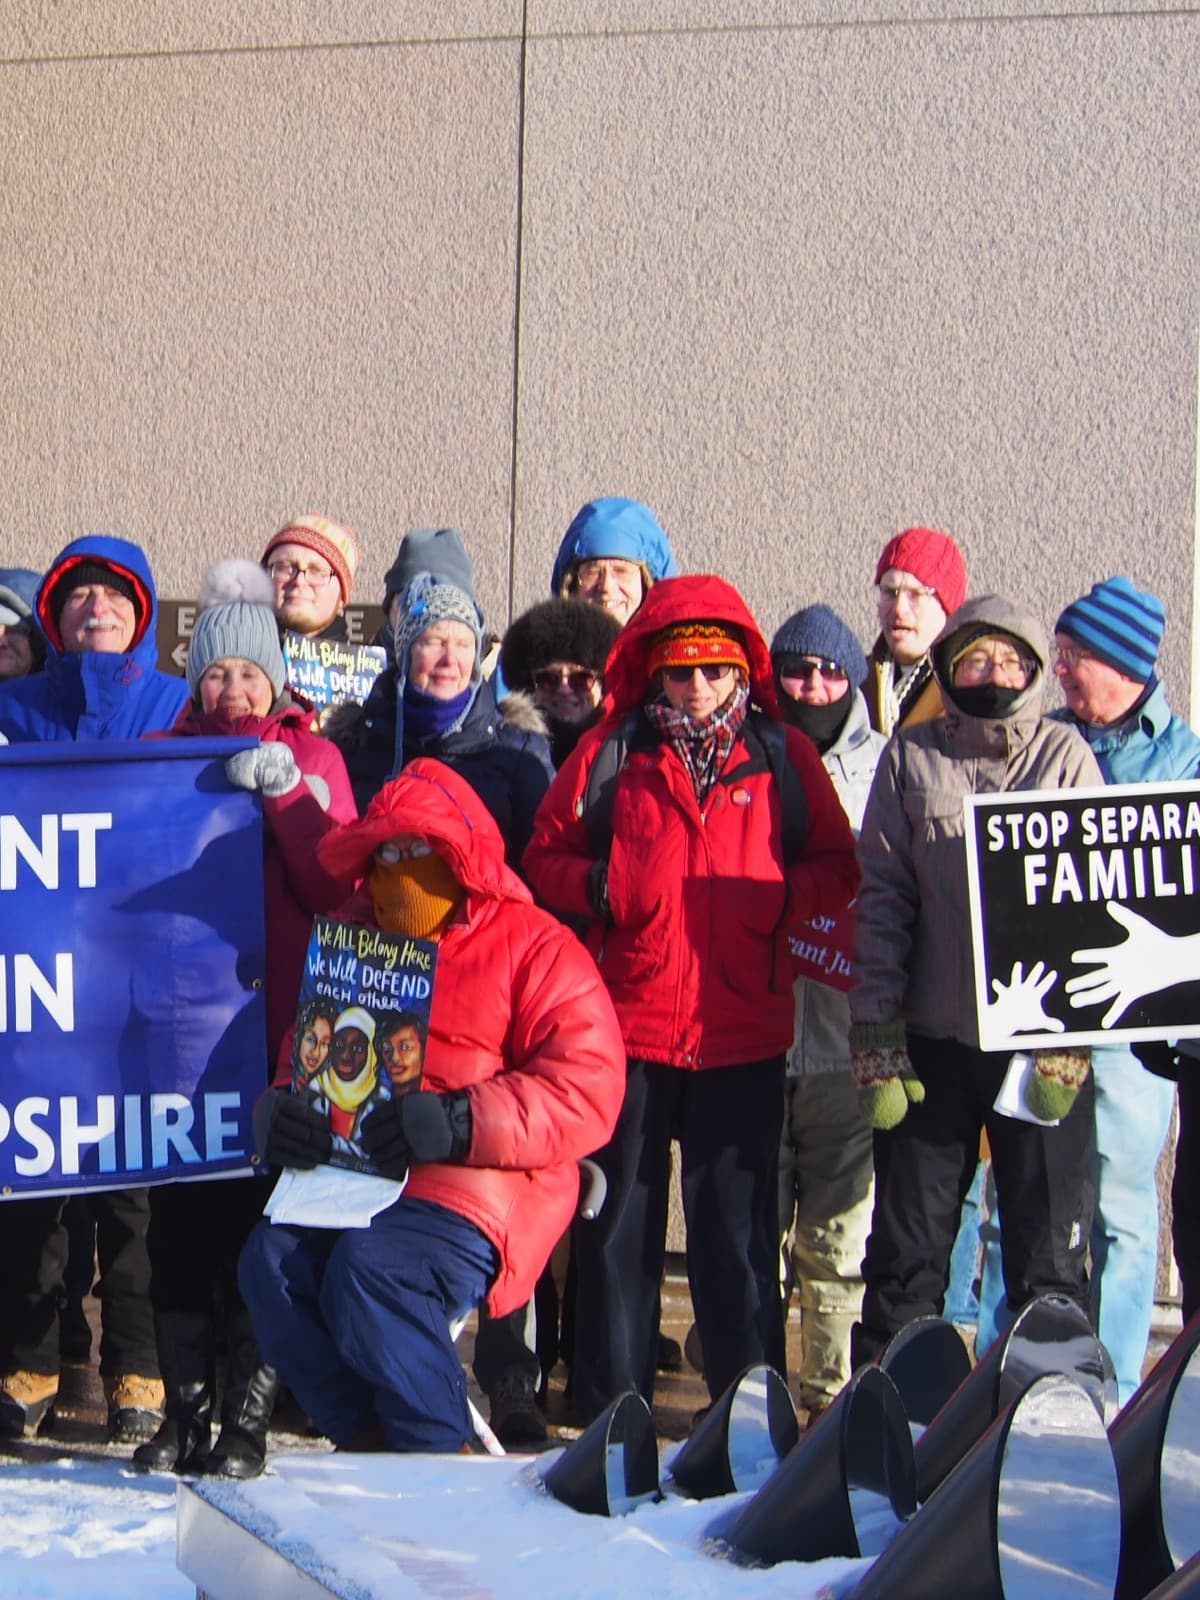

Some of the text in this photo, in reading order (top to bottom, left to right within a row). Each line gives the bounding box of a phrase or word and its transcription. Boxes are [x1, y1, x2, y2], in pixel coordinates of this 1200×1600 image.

[987, 802, 1200, 852] STOP SEPARA
[1024, 844, 1195, 906] FAMILI
[333, 923, 356, 952] ALL
[308, 951, 326, 977] We
[329, 953, 358, 985] Will
